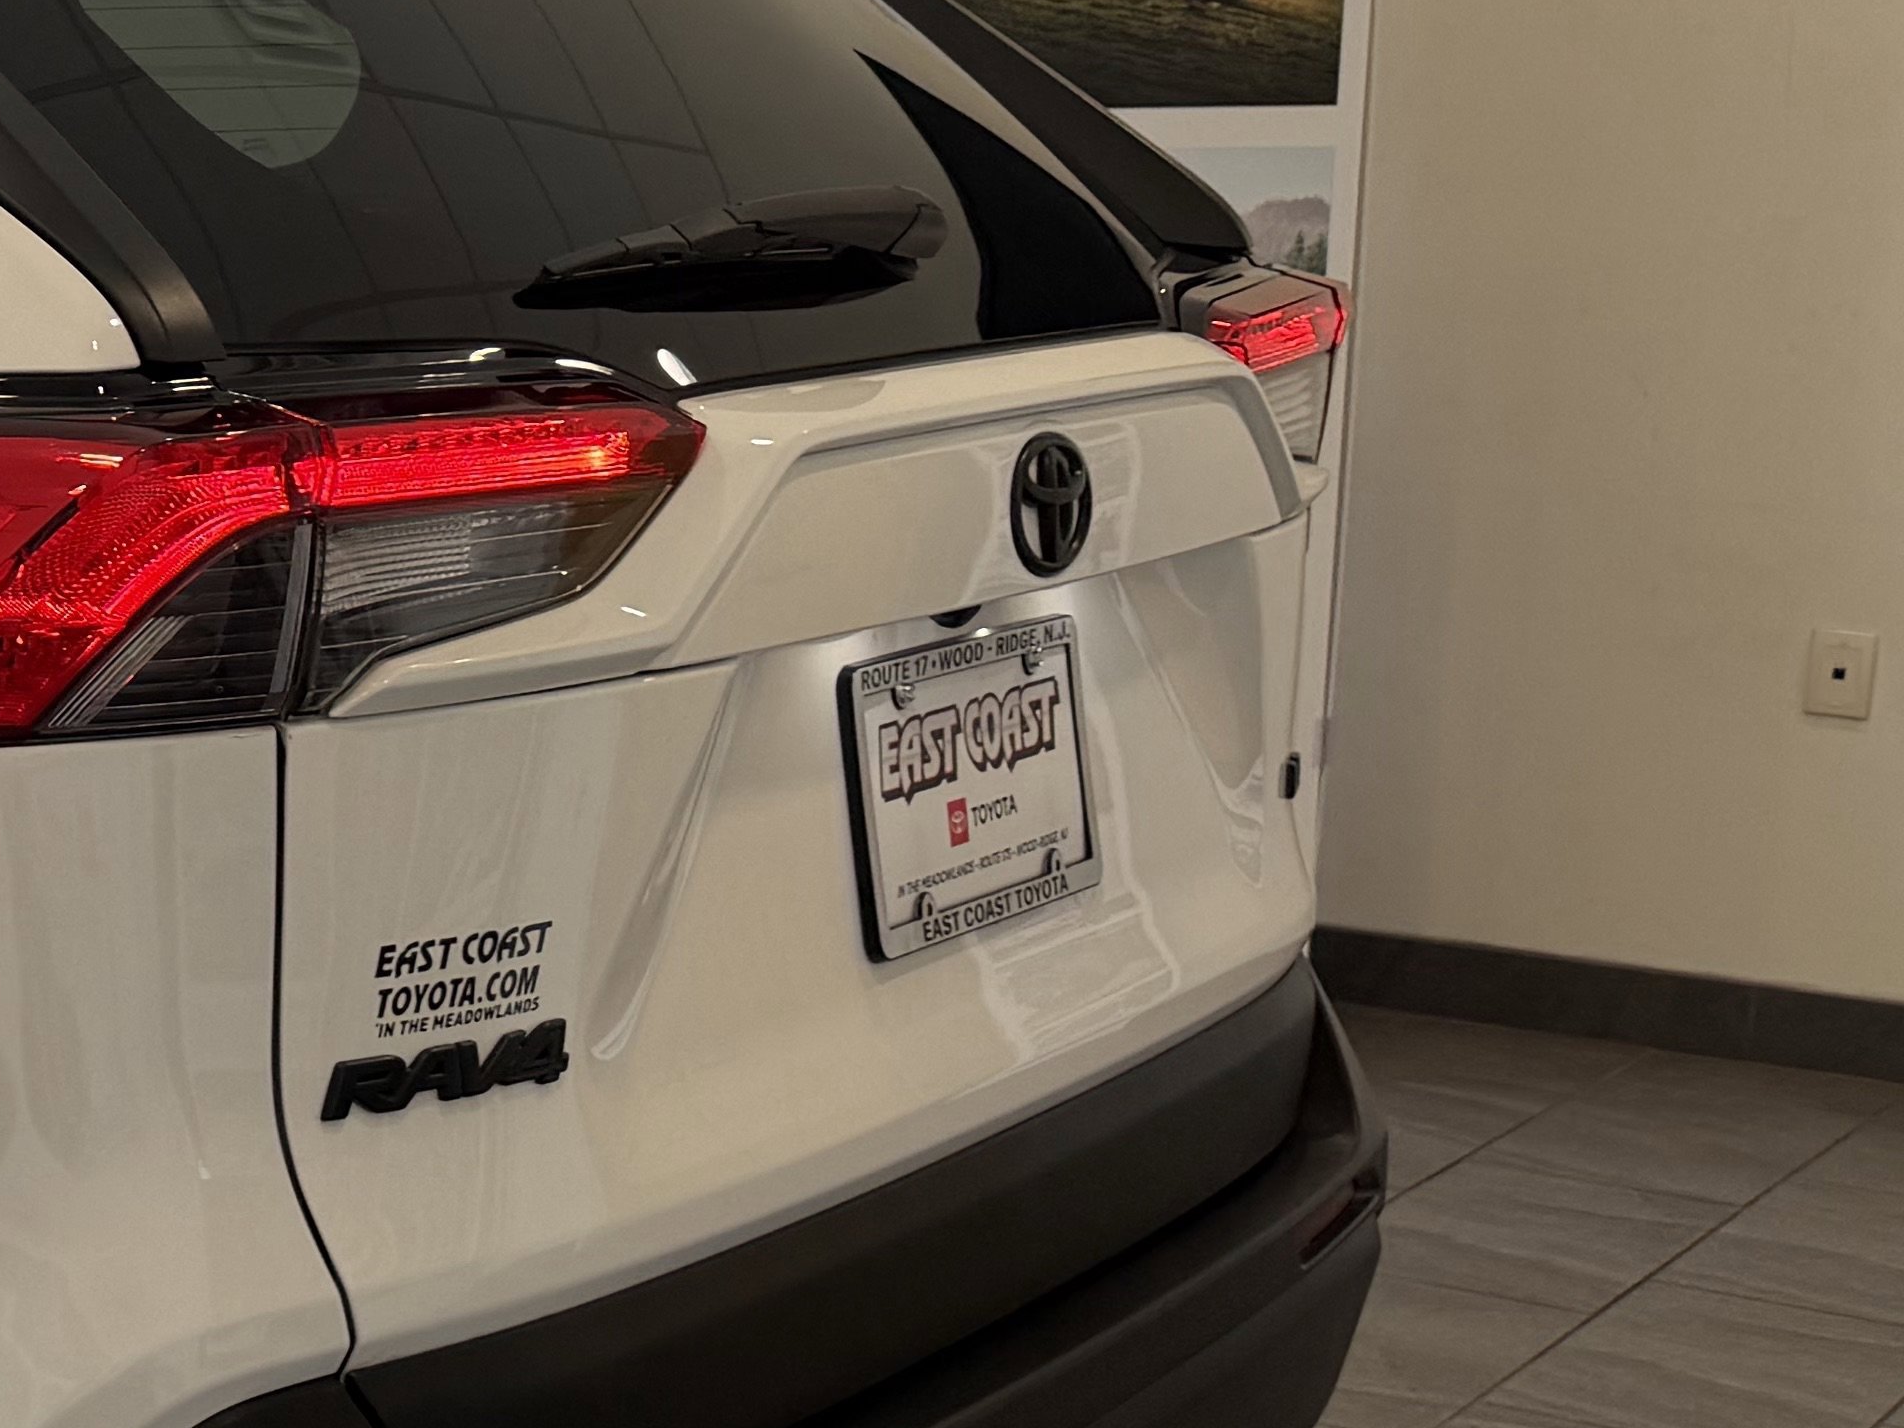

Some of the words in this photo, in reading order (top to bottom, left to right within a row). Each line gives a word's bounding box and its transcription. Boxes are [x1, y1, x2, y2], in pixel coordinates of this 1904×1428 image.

[860, 658, 911, 691] ROUTE
[915, 655, 928, 677] 17
[939, 642, 984, 670] WOOD
[995, 629, 1041, 656] RIDGE,
[878, 703, 963, 805] EAST
[963, 675, 1060, 773] COAST
[971, 794, 1018, 828] TOYOTA
[923, 909, 961, 942] EAST
[964, 893, 1015, 928] COAST
[1017, 872, 1069, 908] TOYOTA
[374, 936, 458, 979] EAST
[462, 920, 553, 965] COAST
[377, 964, 540, 1019] TOYOTA.COM
[400, 1016, 428, 1034] THE
[432, 996, 540, 1031] MEADOWLANDS
[320, 1017, 570, 1122] RAV4
